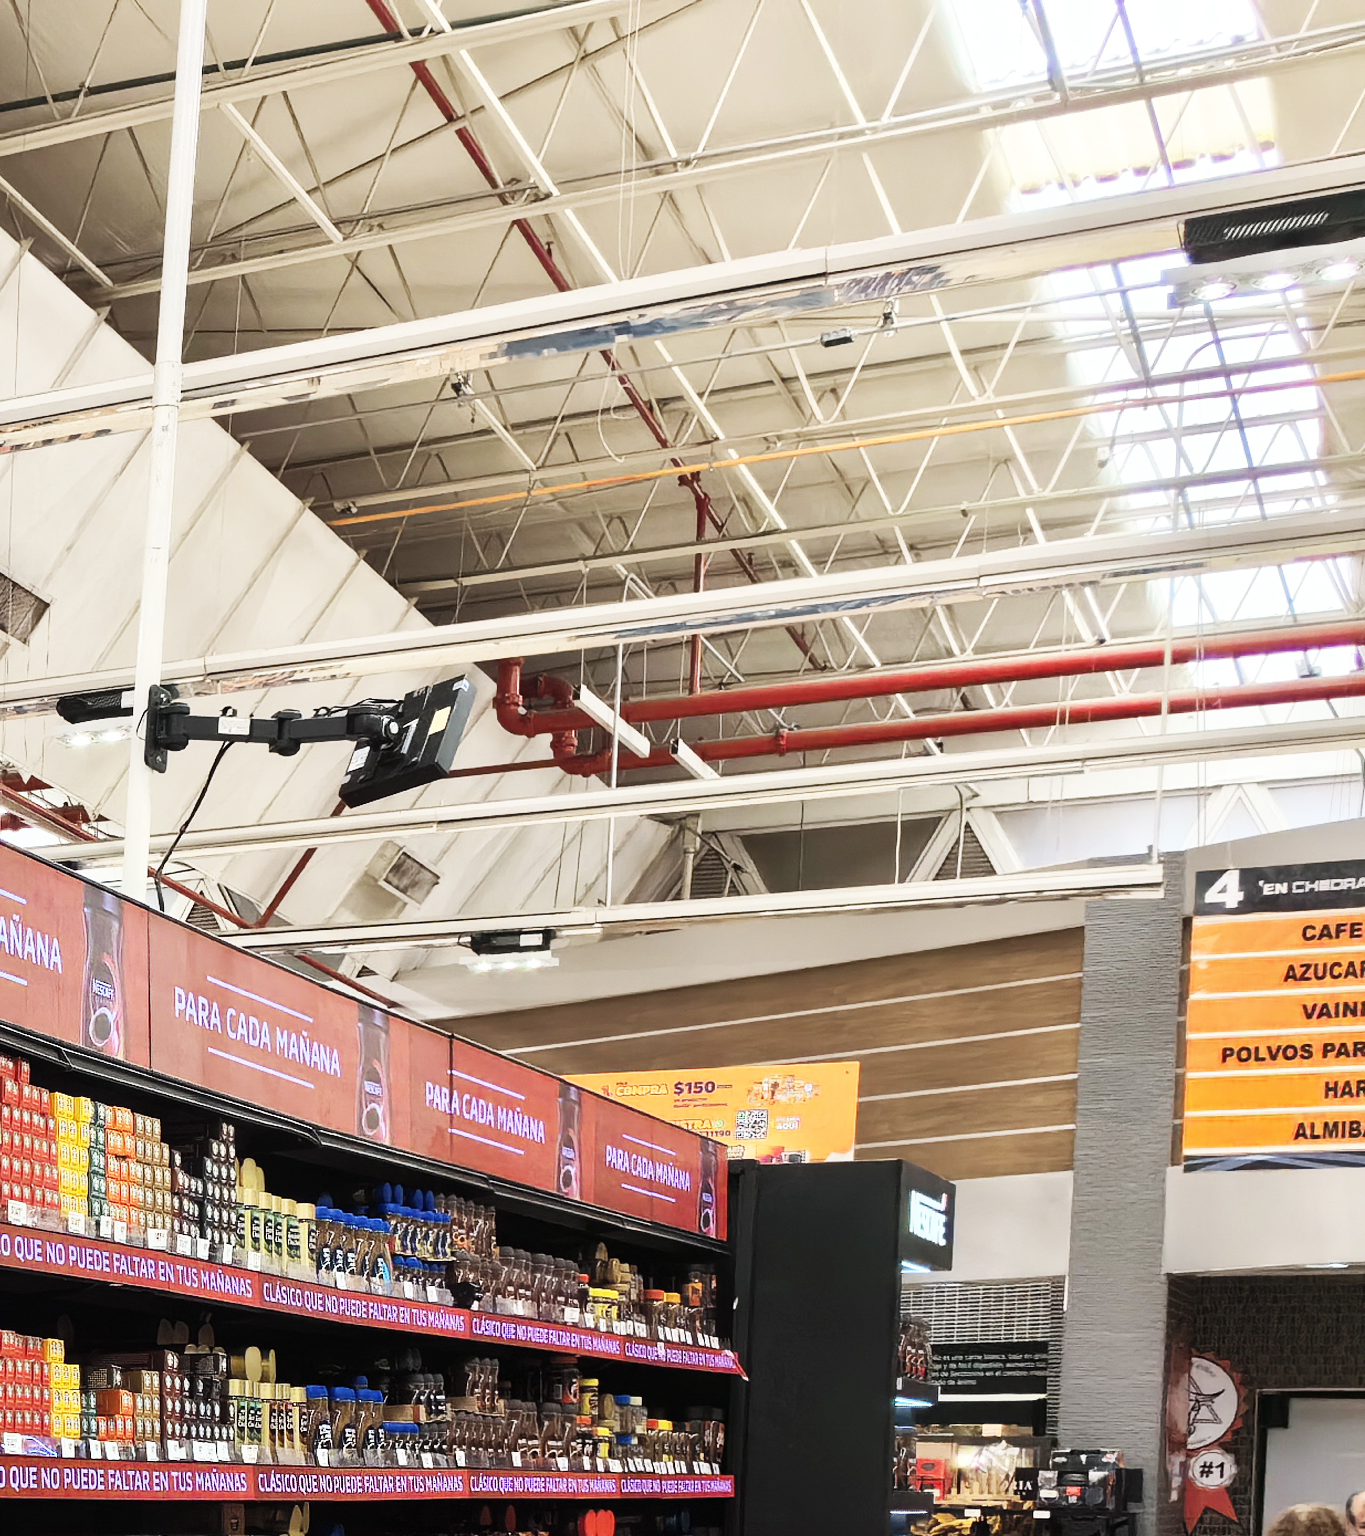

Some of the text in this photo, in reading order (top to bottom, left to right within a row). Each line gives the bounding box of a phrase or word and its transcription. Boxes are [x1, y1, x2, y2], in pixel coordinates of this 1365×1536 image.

[1204, 869, 1244, 909] 4
[174, 986, 341, 1078] PARA CADA MAÑANA
[1221, 1043, 1313, 1063] POLVOS
[673, 1081, 716, 1096] $150
[425, 1081, 546, 1144] PARA CADA MAÑANA
[606, 1145, 691, 1192] PARA CADA MAÑANA
[14, 1235, 42, 1263] QUE
[46, 1240, 67, 1264] NO
[69, 1245, 110, 1273] PUEDE
[113, 1253, 155, 1279] FALTAR
[158, 1261, 175, 1283] EN
[177, 1264, 199, 1286] TUS
[201, 1265, 252, 1298] MAÑANAS
[262, 1282, 464, 1332] CLÁSICO QUE NO PUEDE FALTAR EN TUS MAÑANAS
[1199, 1461, 1226, 1479] #1
